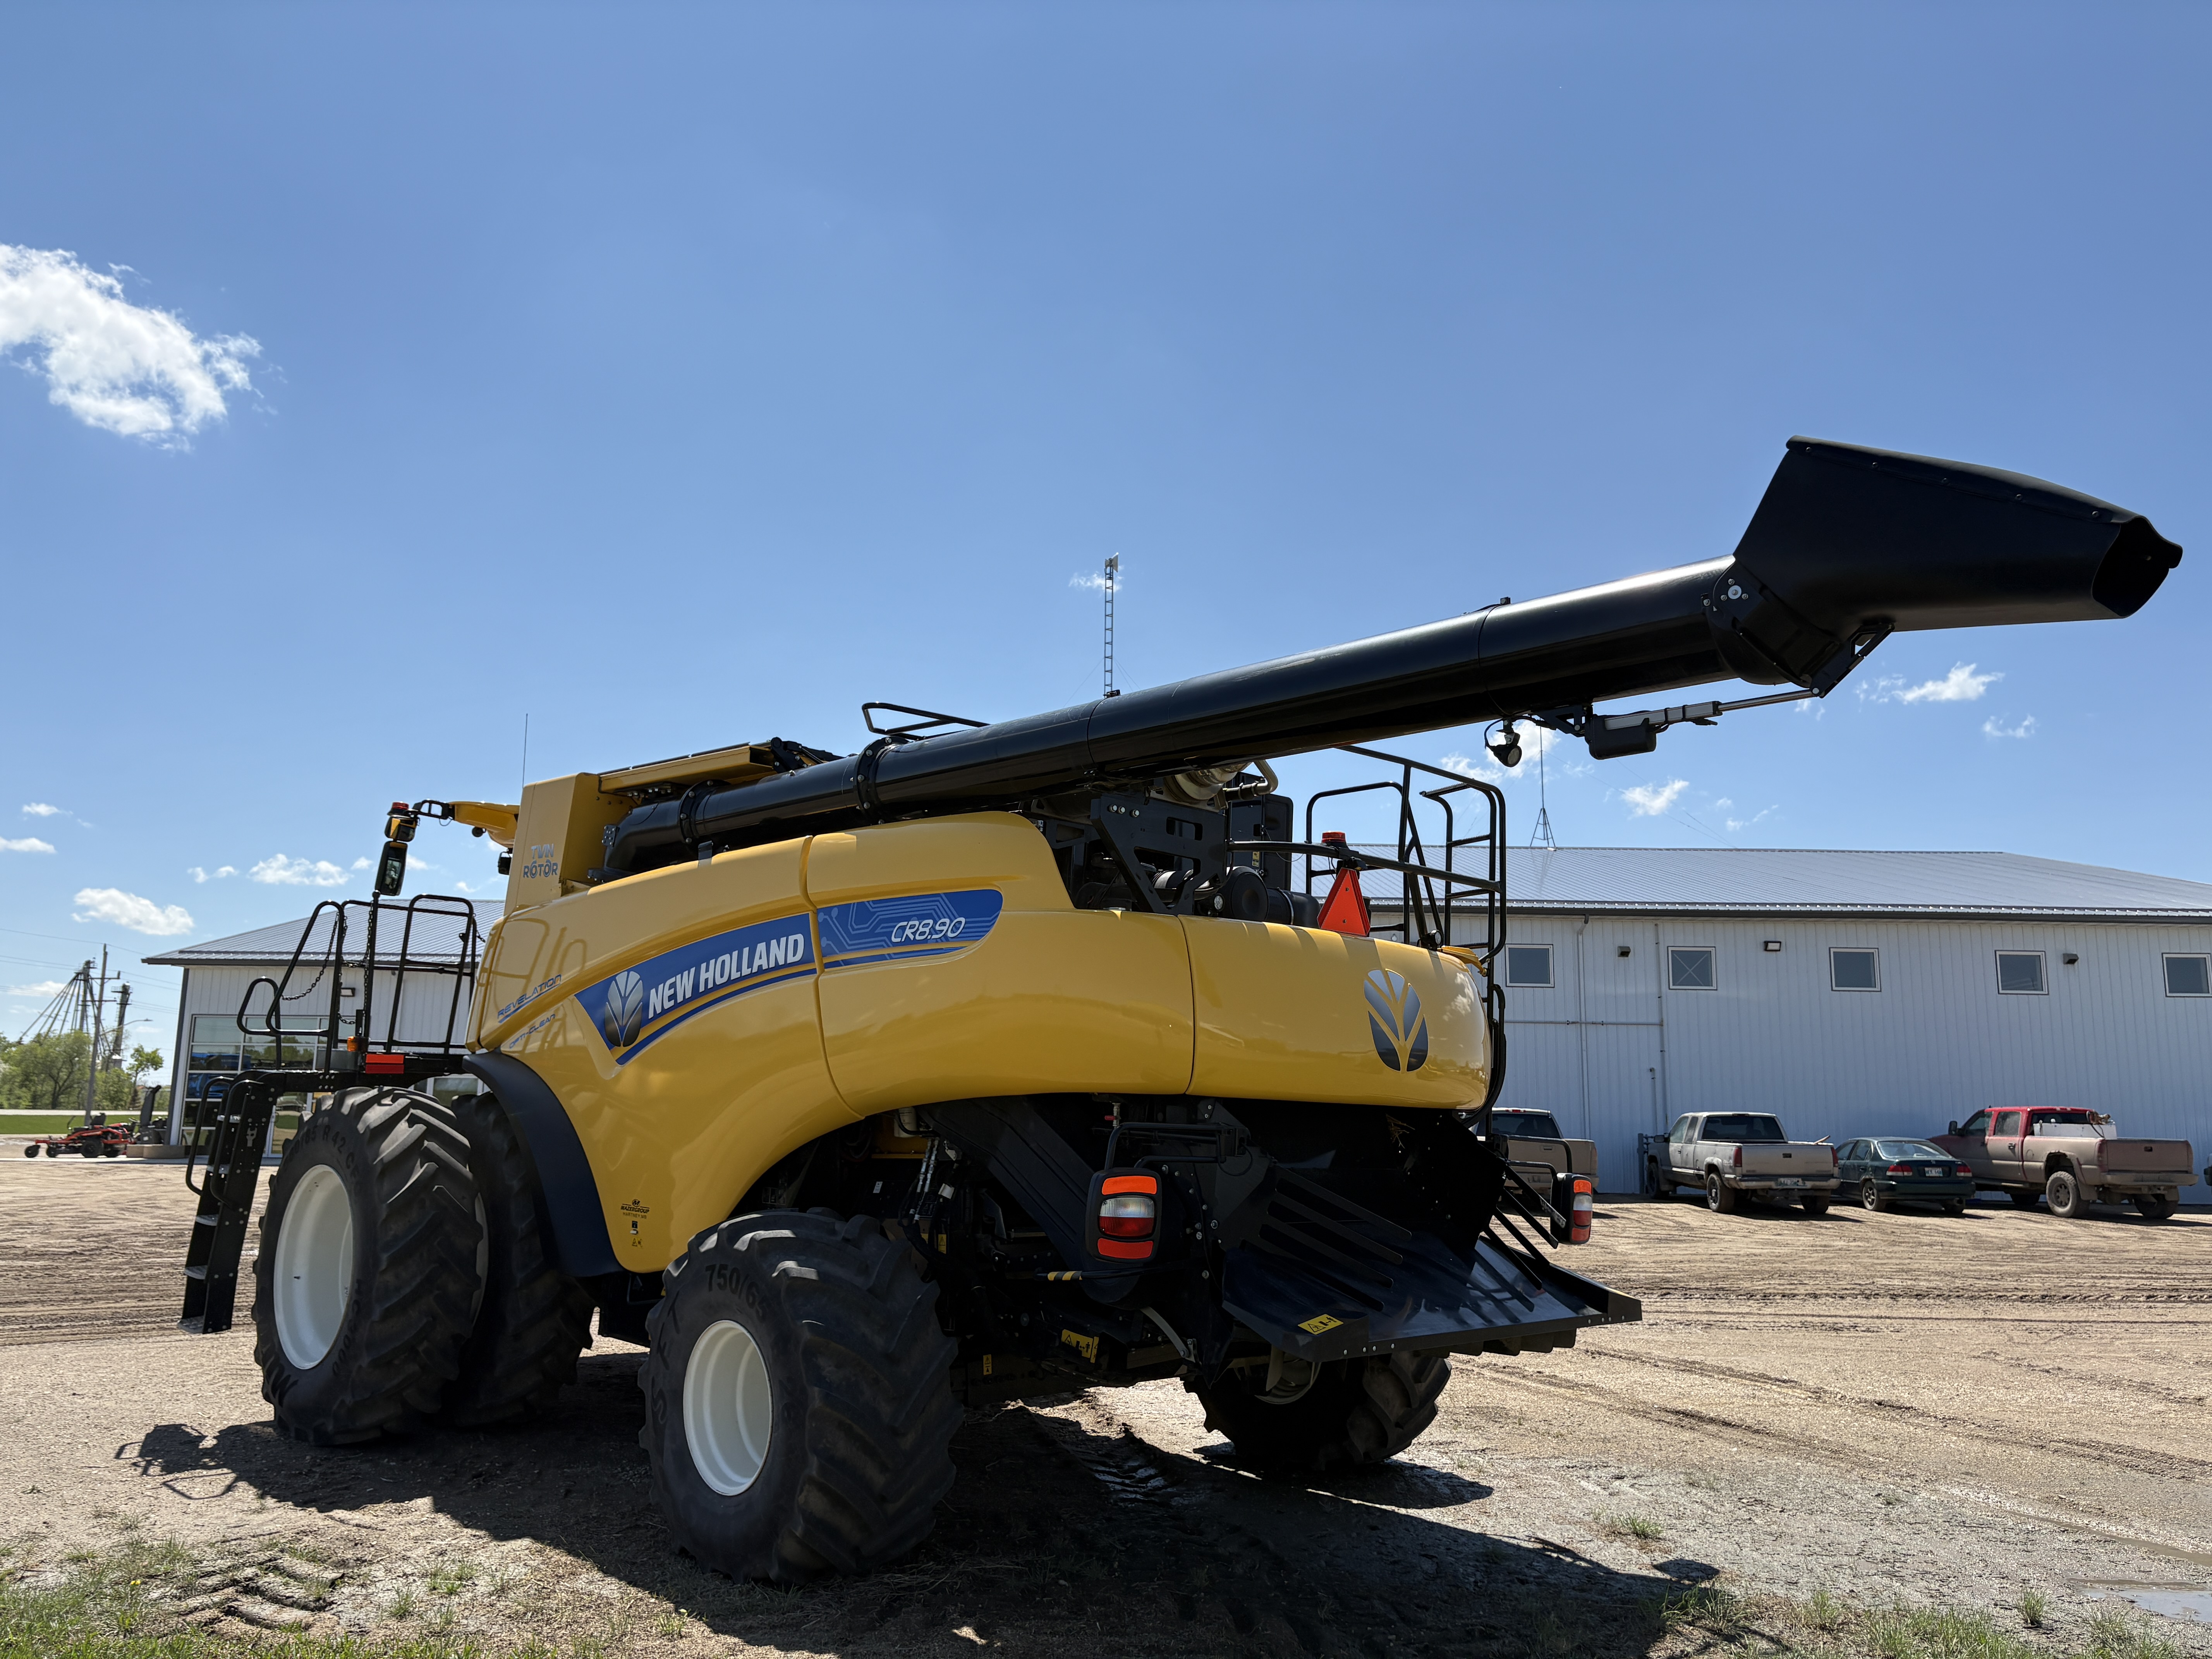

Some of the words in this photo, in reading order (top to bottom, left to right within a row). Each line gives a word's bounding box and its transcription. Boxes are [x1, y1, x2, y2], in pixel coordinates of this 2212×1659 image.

[523, 859, 558, 878] ROTOR
[891, 917, 966, 943] CR8.90
[648, 967, 696, 1019] NEW
[699, 933, 805, 993] HOLLAND
[497, 974, 562, 1019] REVELATION
[509, 1013, 556, 1049] OPTI-CLEAN
[331, 1131, 346, 1154] 42
[705, 1263, 770, 1322] 750/65
